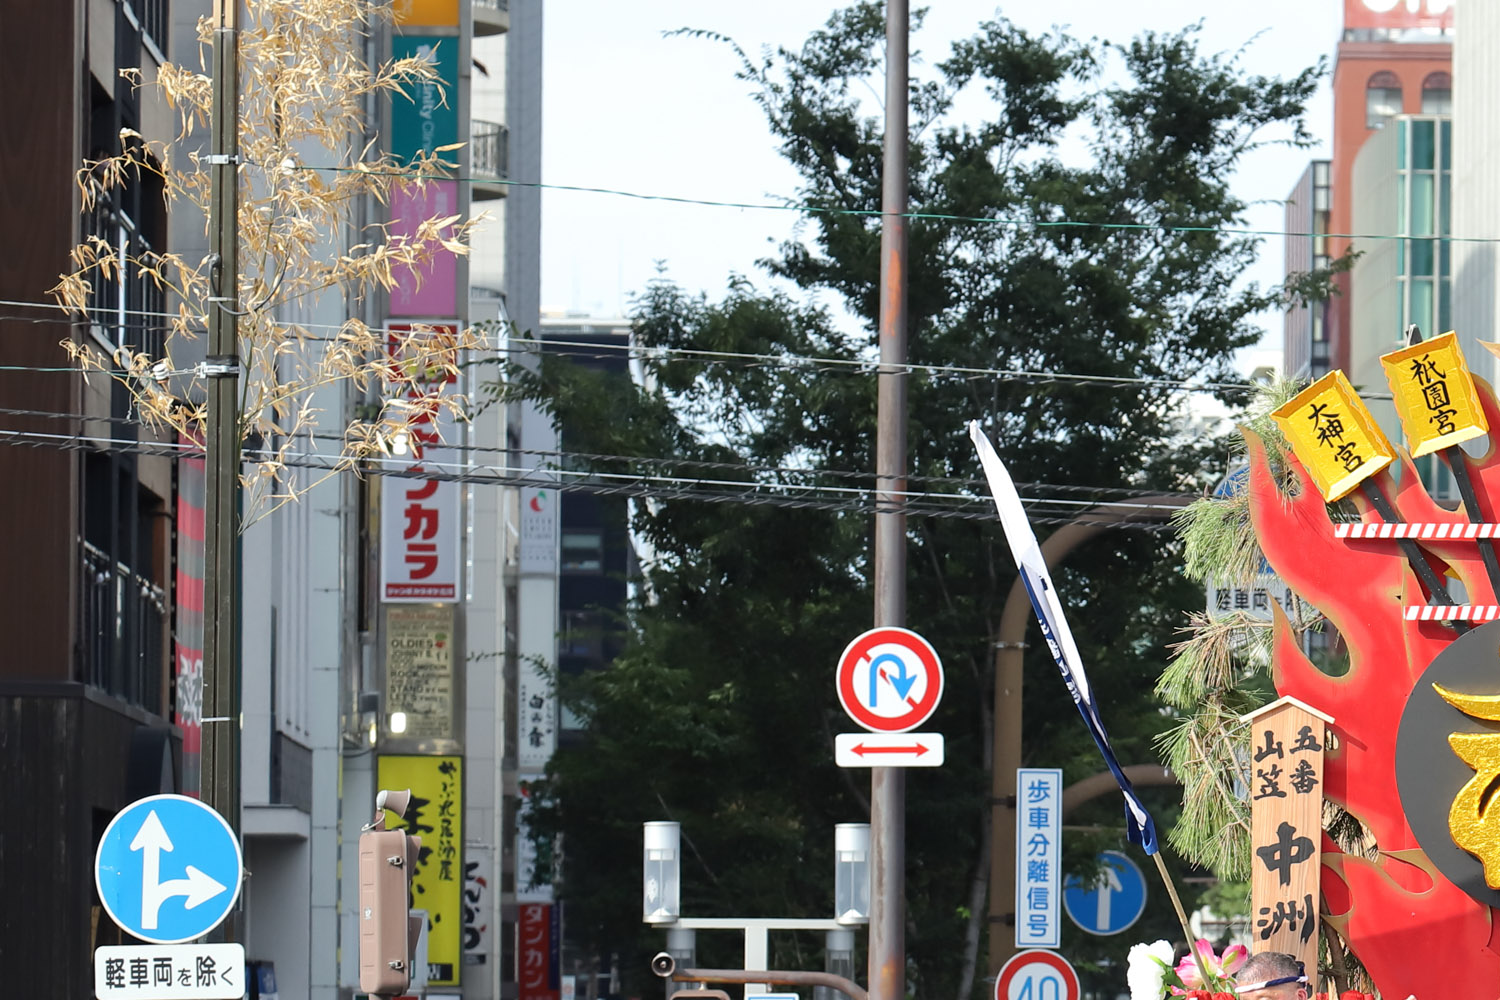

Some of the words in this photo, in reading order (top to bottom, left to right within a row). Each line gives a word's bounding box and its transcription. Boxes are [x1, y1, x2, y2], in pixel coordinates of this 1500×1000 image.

[1409, 354, 1458, 436] 祇園宮
[1307, 402, 1366, 473] 大神宮
[391, 639, 434, 649] OLDIES
[1253, 730, 1288, 800] 山笠
[1289, 725, 1322, 794] 五番
[1027, 779, 1052, 939] 歩車分離信号
[1256, 821, 1316, 965] 中洲
[105, 956, 235, 991] 軽車両を除く
[525, 905, 544, 988] ダンカン
